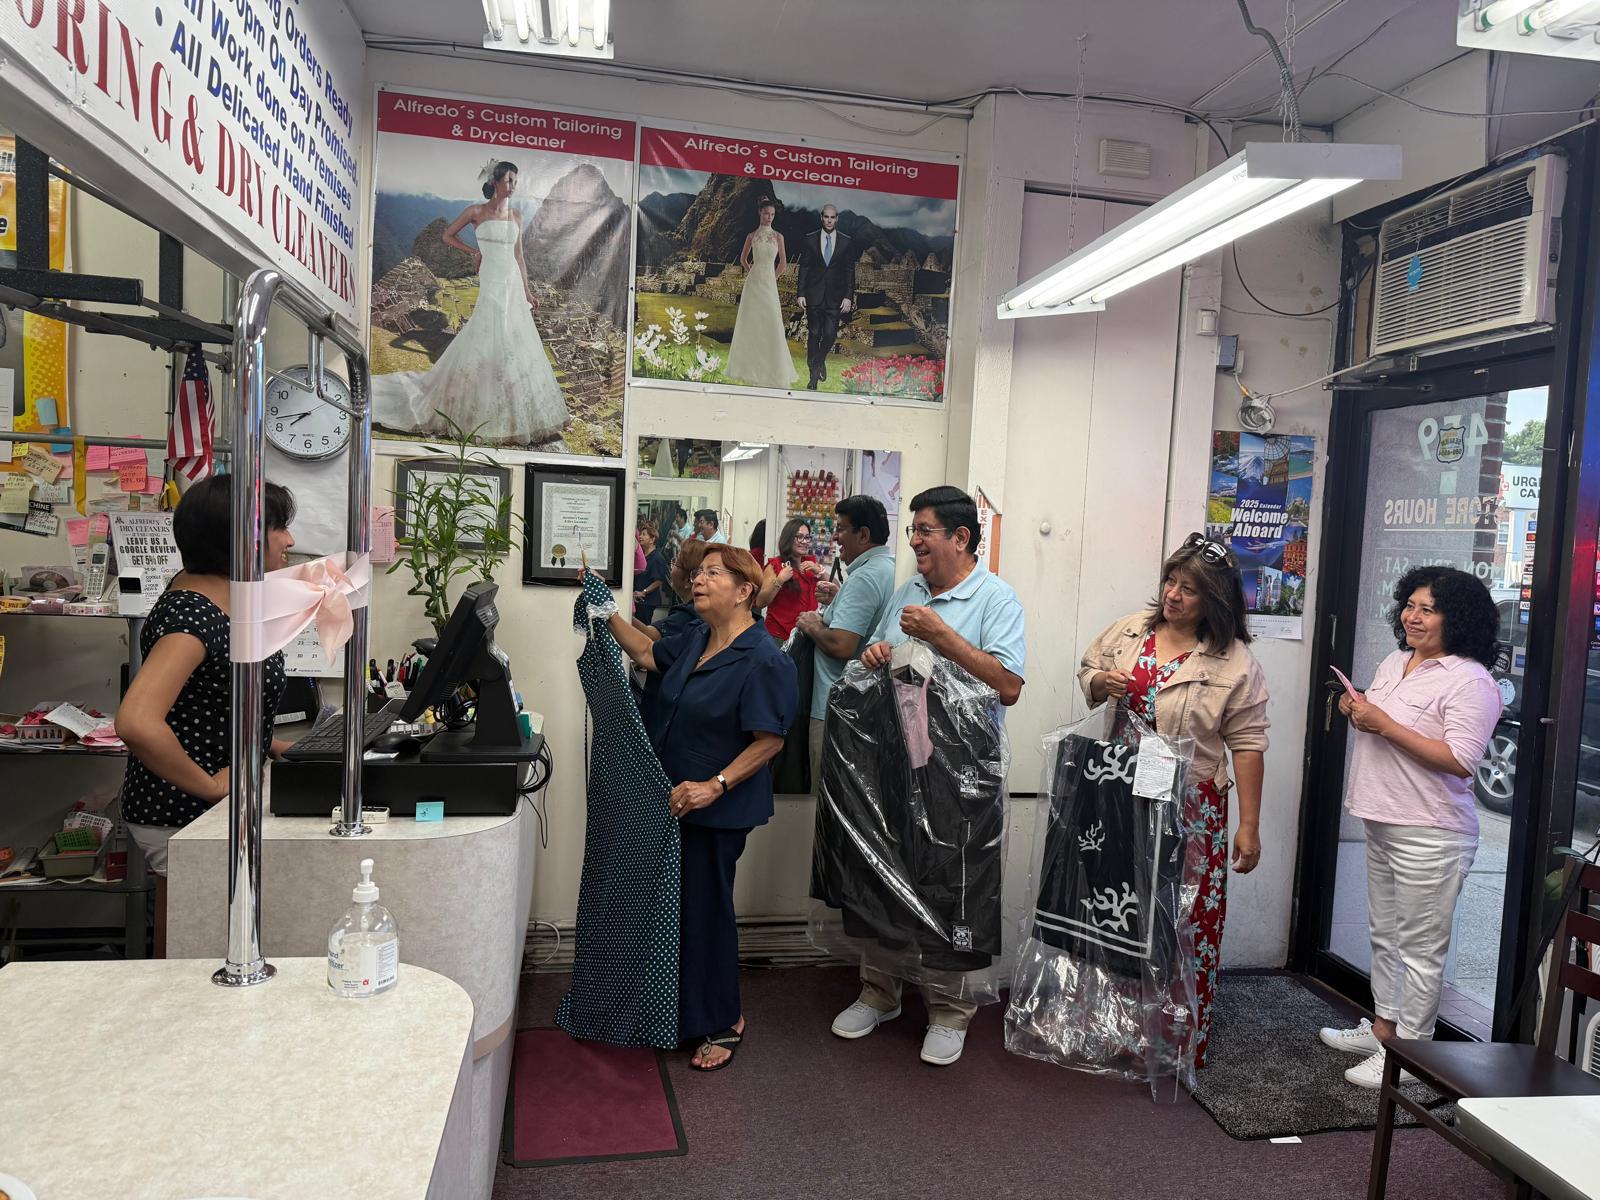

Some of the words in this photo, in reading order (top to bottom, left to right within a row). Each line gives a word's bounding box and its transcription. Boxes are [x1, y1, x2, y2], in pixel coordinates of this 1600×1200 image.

[286, 7, 322, 88] Orders
[325, 70, 353, 138] Ready
[211, 0, 252, 86] Work
[256, 71, 287, 130] done
[291, 121, 305, 155] on
[308, 136, 352, 210] Premises
[270, 34, 286, 83] On
[290, 64, 312, 125] Day
[314, 101, 359, 188] Promised.
[481, 109, 547, 129] Custom
[552, 117, 622, 140] Tailoring
[170, 20, 202, 78] All
[207, 56, 280, 168] Delicated
[283, 148, 313, 205] Hand
[315, 187, 354, 250] Finished
[451, 124, 464, 137] &
[470, 126, 566, 150] Drycleaner
[774, 148, 842, 168] Custom
[847, 156, 919, 179] Tailoring
[743, 162, 756, 175] &
[762, 164, 862, 187] Drycleaner
[182, 94, 206, 175] &
[216, 120, 267, 229] DRY
[272, 184, 356, 309] CLEANERS
[324, 383, 328, 392] 1
[277, 390, 289, 400] 10
[334, 394, 342, 405] 2
[270, 406, 279, 416] 9
[339, 410, 347, 421] 3
[276, 423, 283, 432] 8
[333, 426, 341, 435] 4
[289, 434, 296, 443] 7
[304, 440, 312, 448] 6
[321, 436, 330, 446] 5
[1512, 476, 1540, 487] URG
[1520, 489, 1540, 498] CA
[1240, 500, 1259, 508] 2025
[1230, 508, 1289, 525] Welcome
[1233, 523, 1283, 539] Aboard
[126, 537, 148, 545] LEAVE
[120, 546, 148, 554] GOOGLE
[150, 546, 176, 554] REVIEW
[132, 555, 144, 565] GET
[157, 556, 168, 566] OFF
